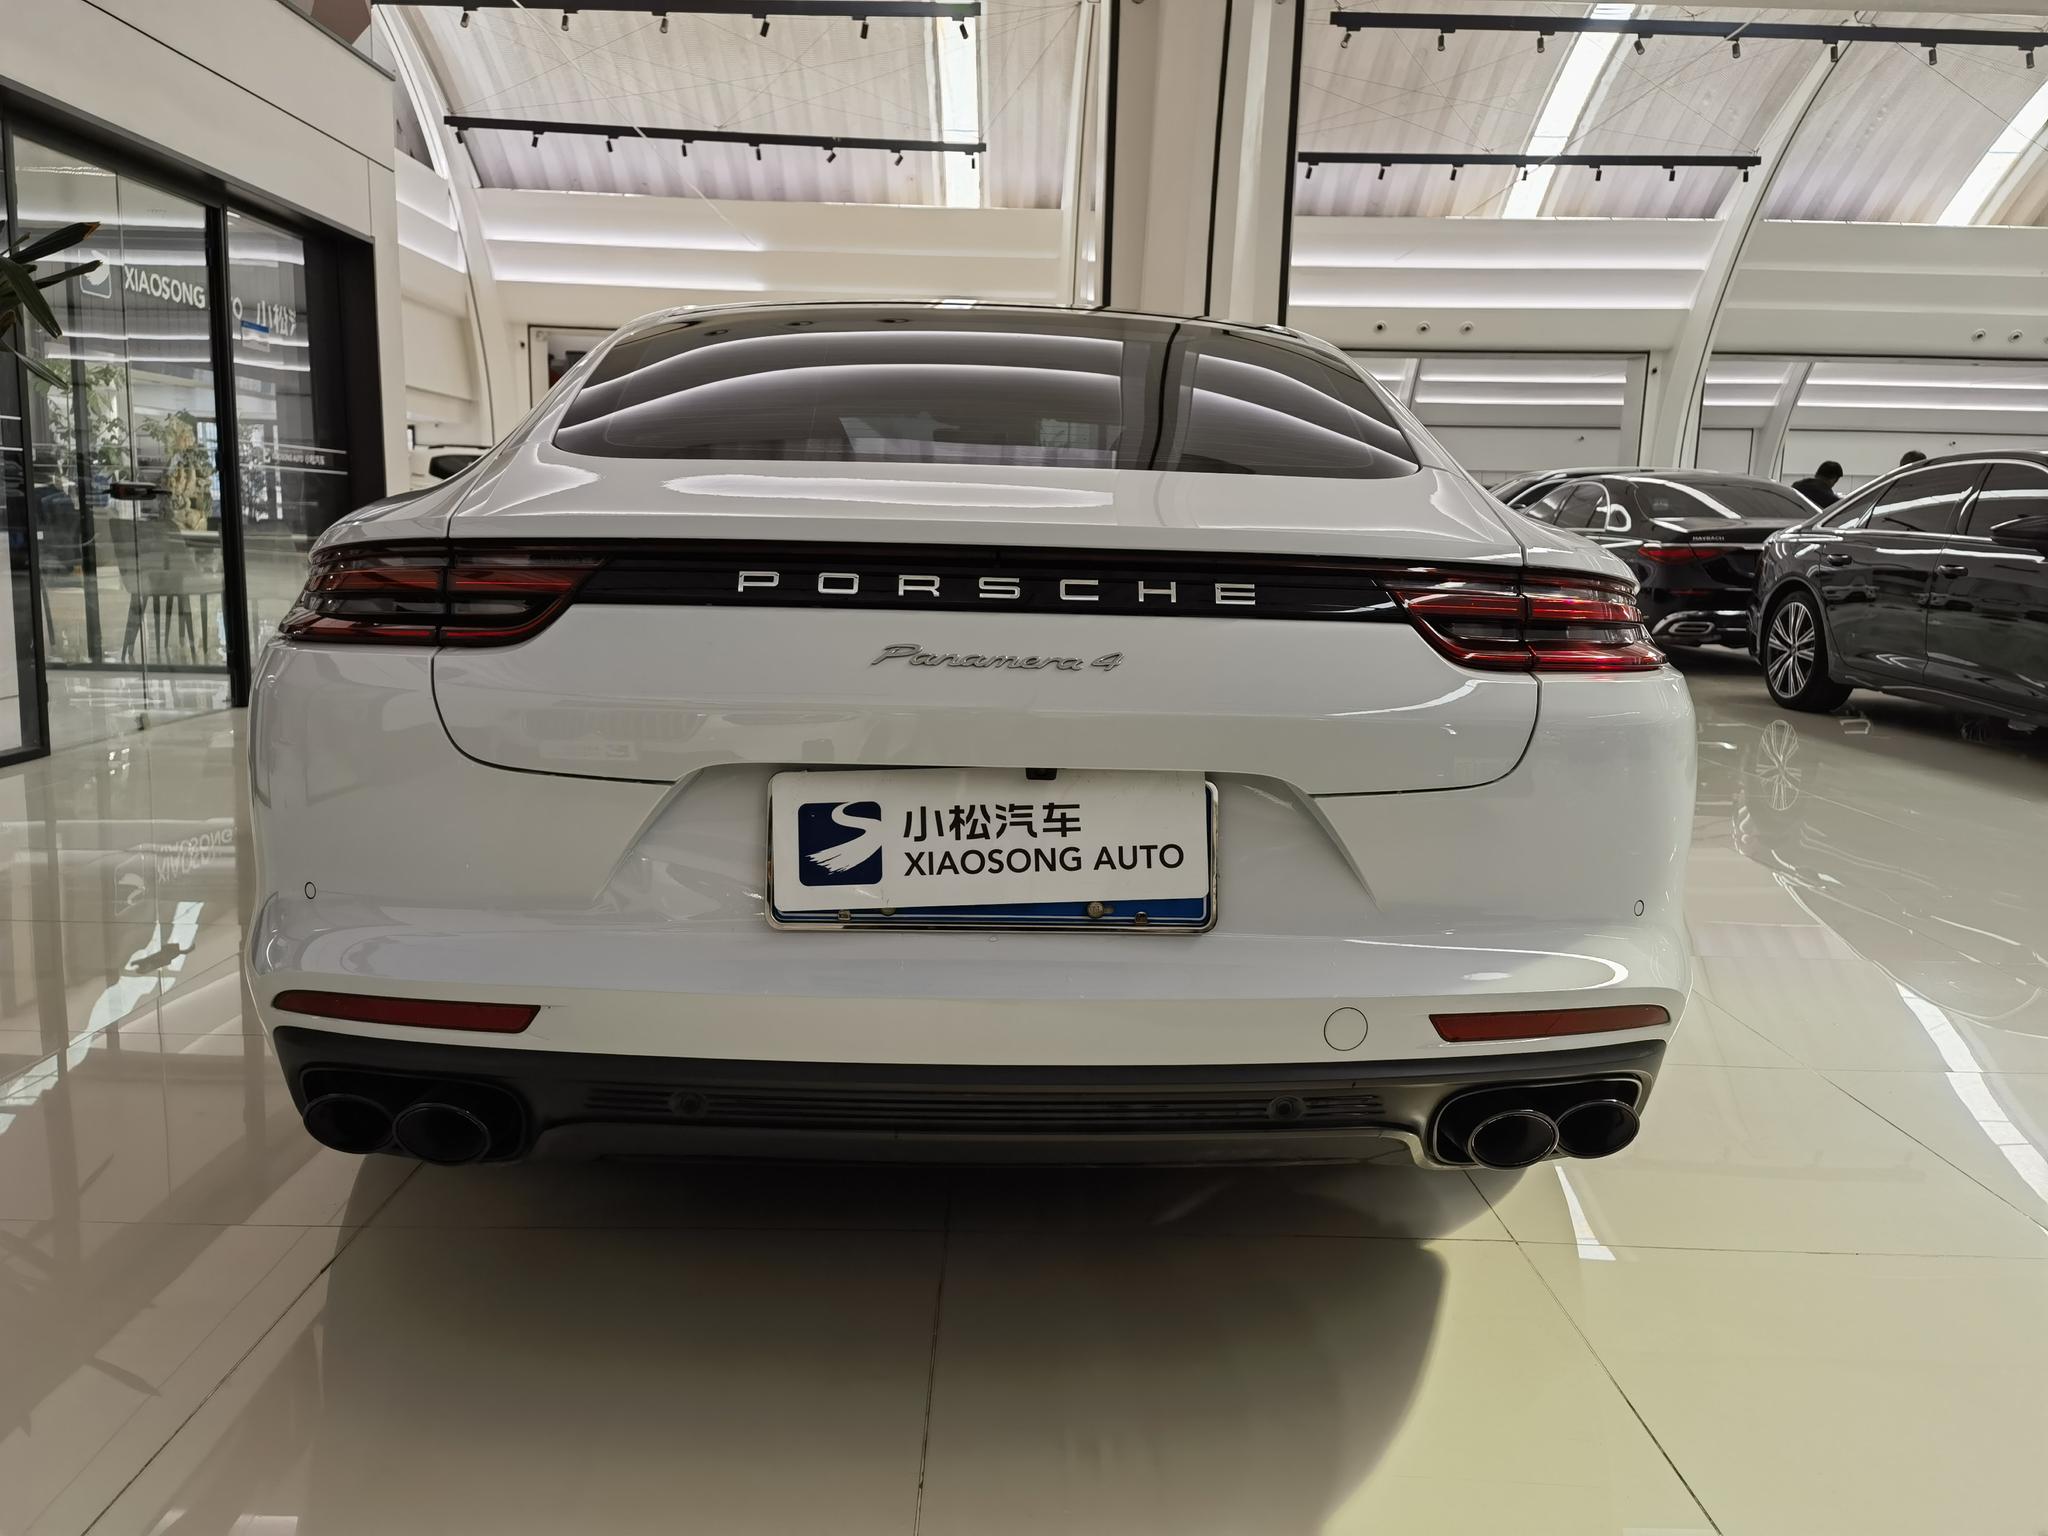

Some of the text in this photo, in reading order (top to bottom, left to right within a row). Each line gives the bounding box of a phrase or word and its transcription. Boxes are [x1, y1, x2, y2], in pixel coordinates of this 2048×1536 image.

[124, 265, 206, 309] XIAOSONG
[738, 571, 1255, 605] PORSCHE
[870, 643, 1124, 672] Panamera 4
[903, 803, 1081, 842] 小松汽车
[904, 843, 1185, 876] XIAOSONG AUTO
